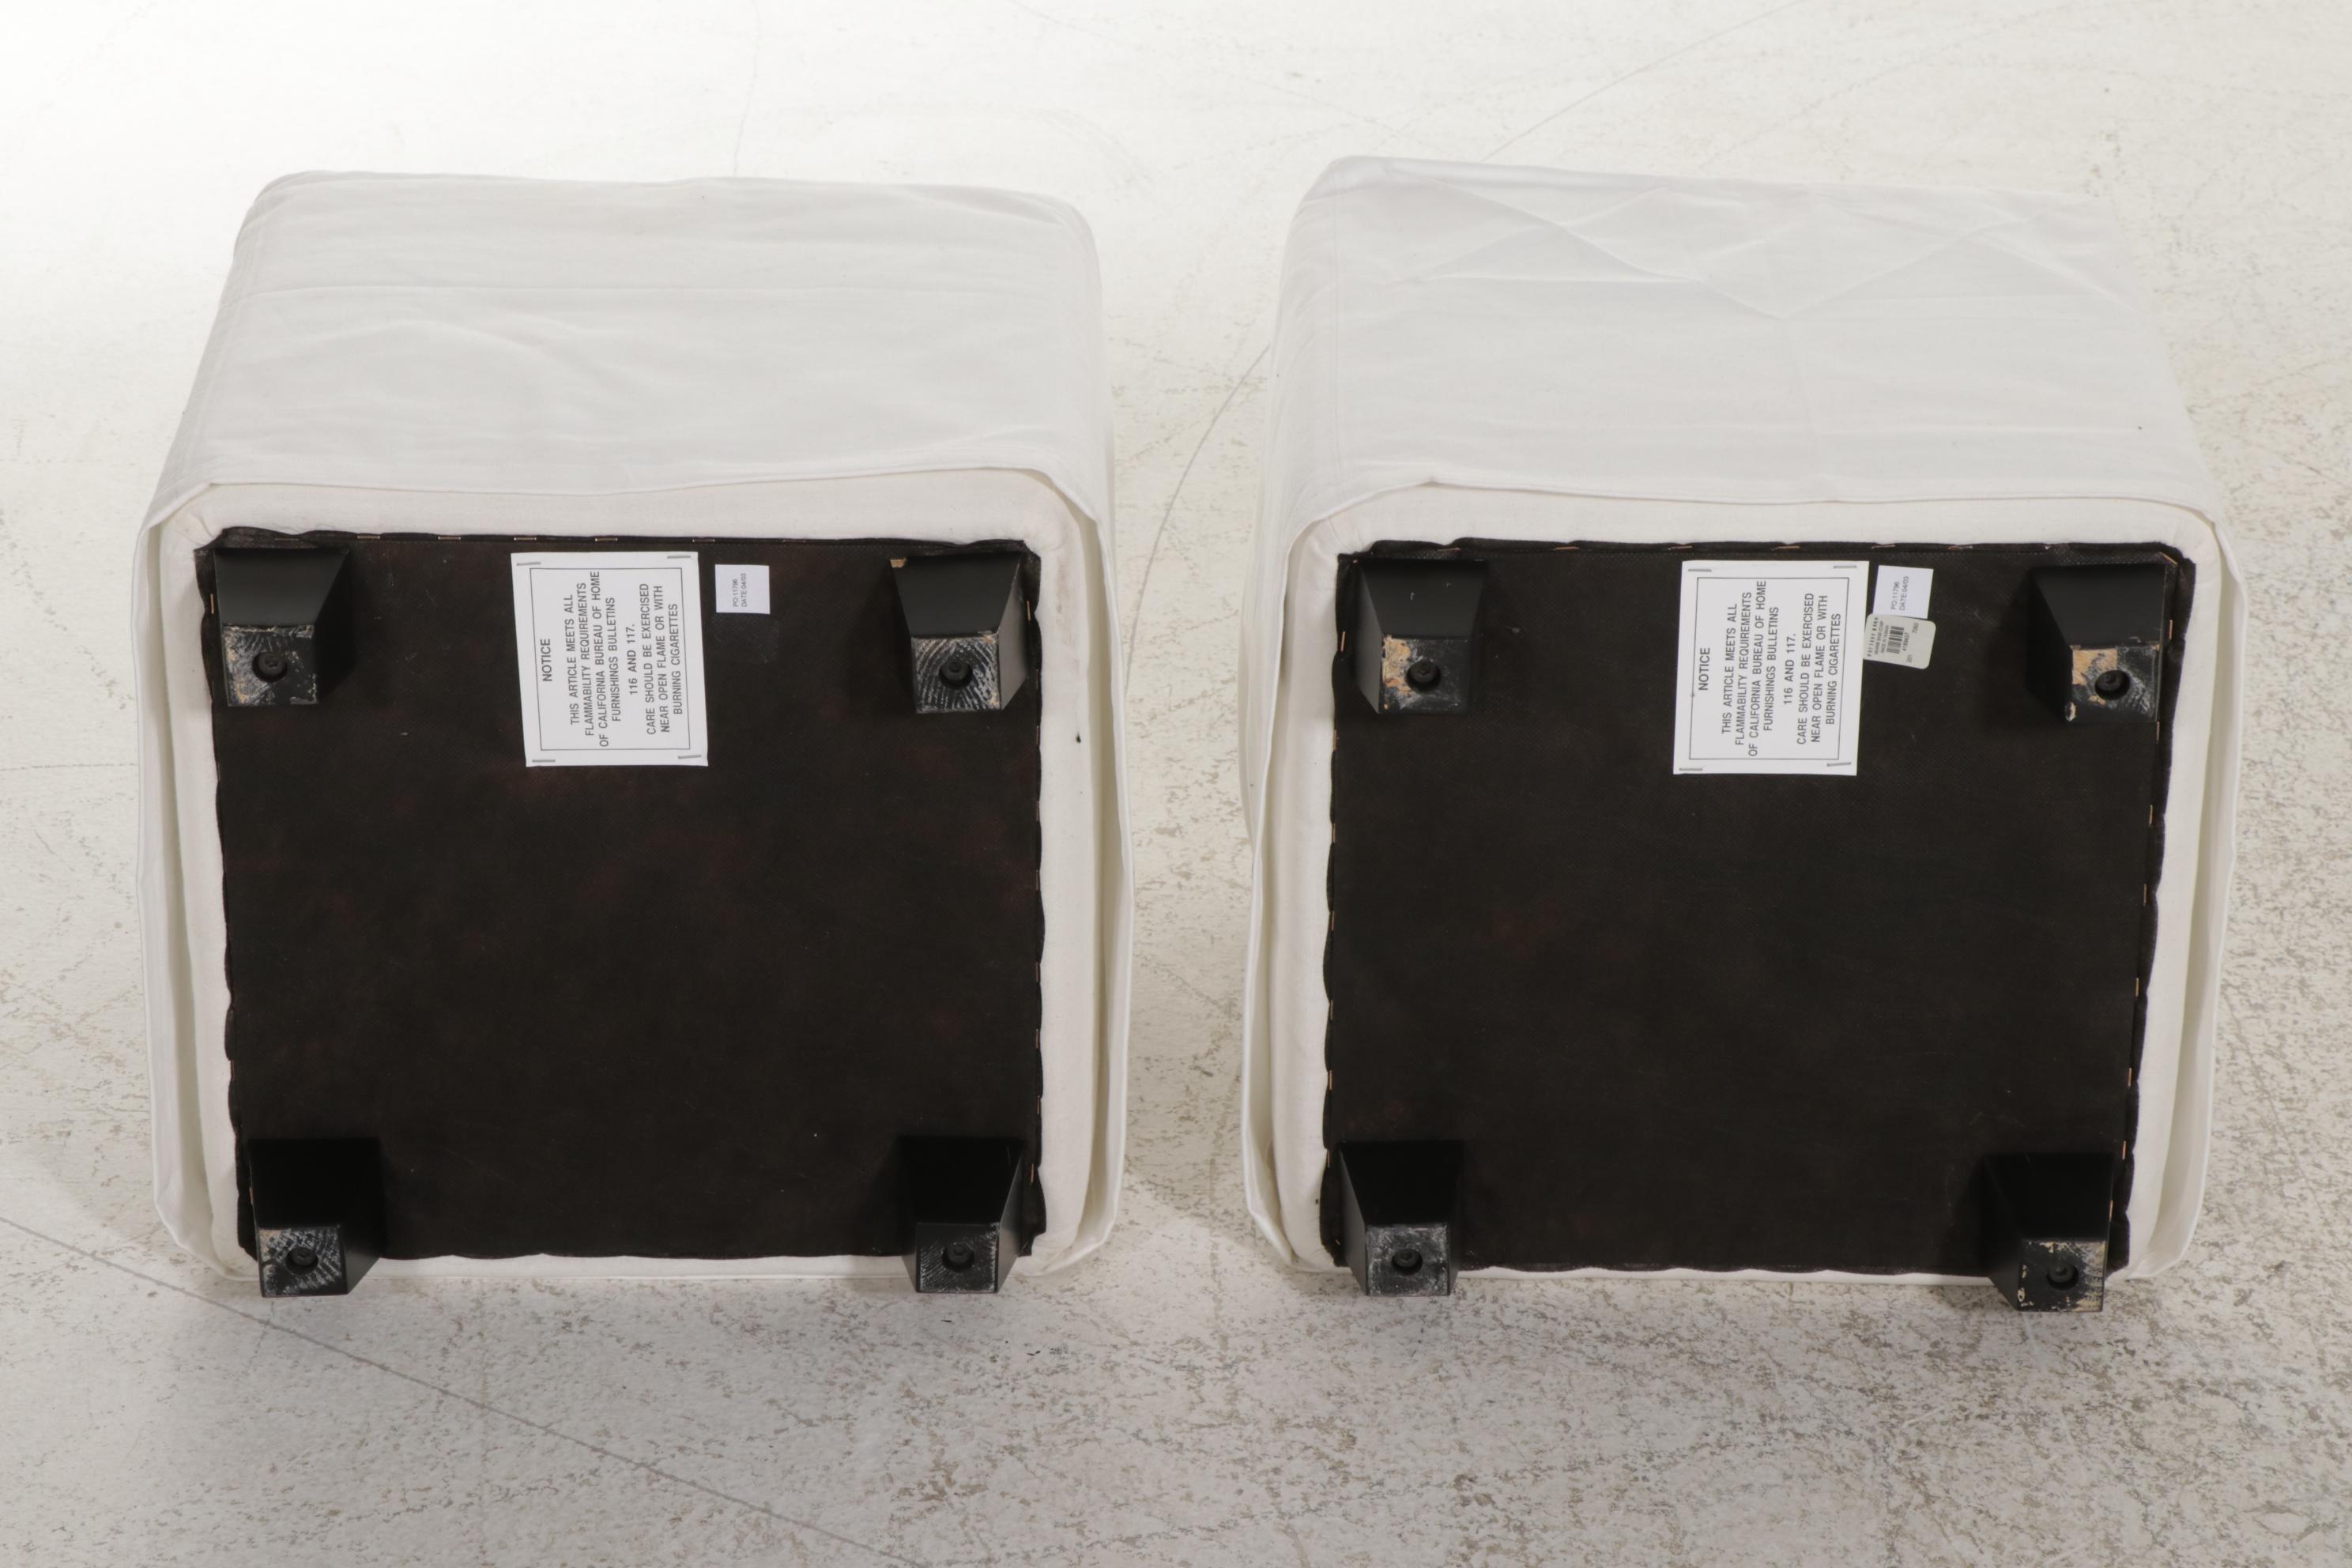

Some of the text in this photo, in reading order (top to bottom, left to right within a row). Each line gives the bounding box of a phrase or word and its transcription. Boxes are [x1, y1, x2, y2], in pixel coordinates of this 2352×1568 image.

[540, 639, 552, 681] NOTICE
[564, 595, 579, 725] THIS ARTICLE MEETS ALL
[577, 582, 594, 736] FLAMMABILITY REQUIREMENTS
[590, 571, 609, 747] OF CALIFORNIA BUREAU OF HOME
[605, 597, 621, 722] FURNISHINGS BULLETINS
[626, 624, 638, 695] 116 AND 117.
[639, 584, 656, 734] CARE SHOULD BE EXERCISED
[654, 586, 669, 732] NEAR OPEN FLAME OR WITH
[668, 604, 683, 714] BURNING CIGARETTES
[1698, 648, 1710, 691] NOTICE
[1721, 604, 1737, 733] THIS ARTICLE MEETS ALL
[1735, 592, 1751, 745] FLAMMABILITY REQUIREMENTS
[1748, 582, 1766, 756] OF CALIFORNIA BUREAU OF HOME
[1763, 607, 1778, 730] FURNISHINGS BULLETINS
[1784, 633, 1796, 704] 116 AND 117.
[1797, 594, 1814, 744] CARE SHOULD BE EXERCISED
[1811, 596, 1827, 742] NEAR OPEN FLAME OR WITH
[1826, 613, 1841, 724] BURNING CIGARETTES
